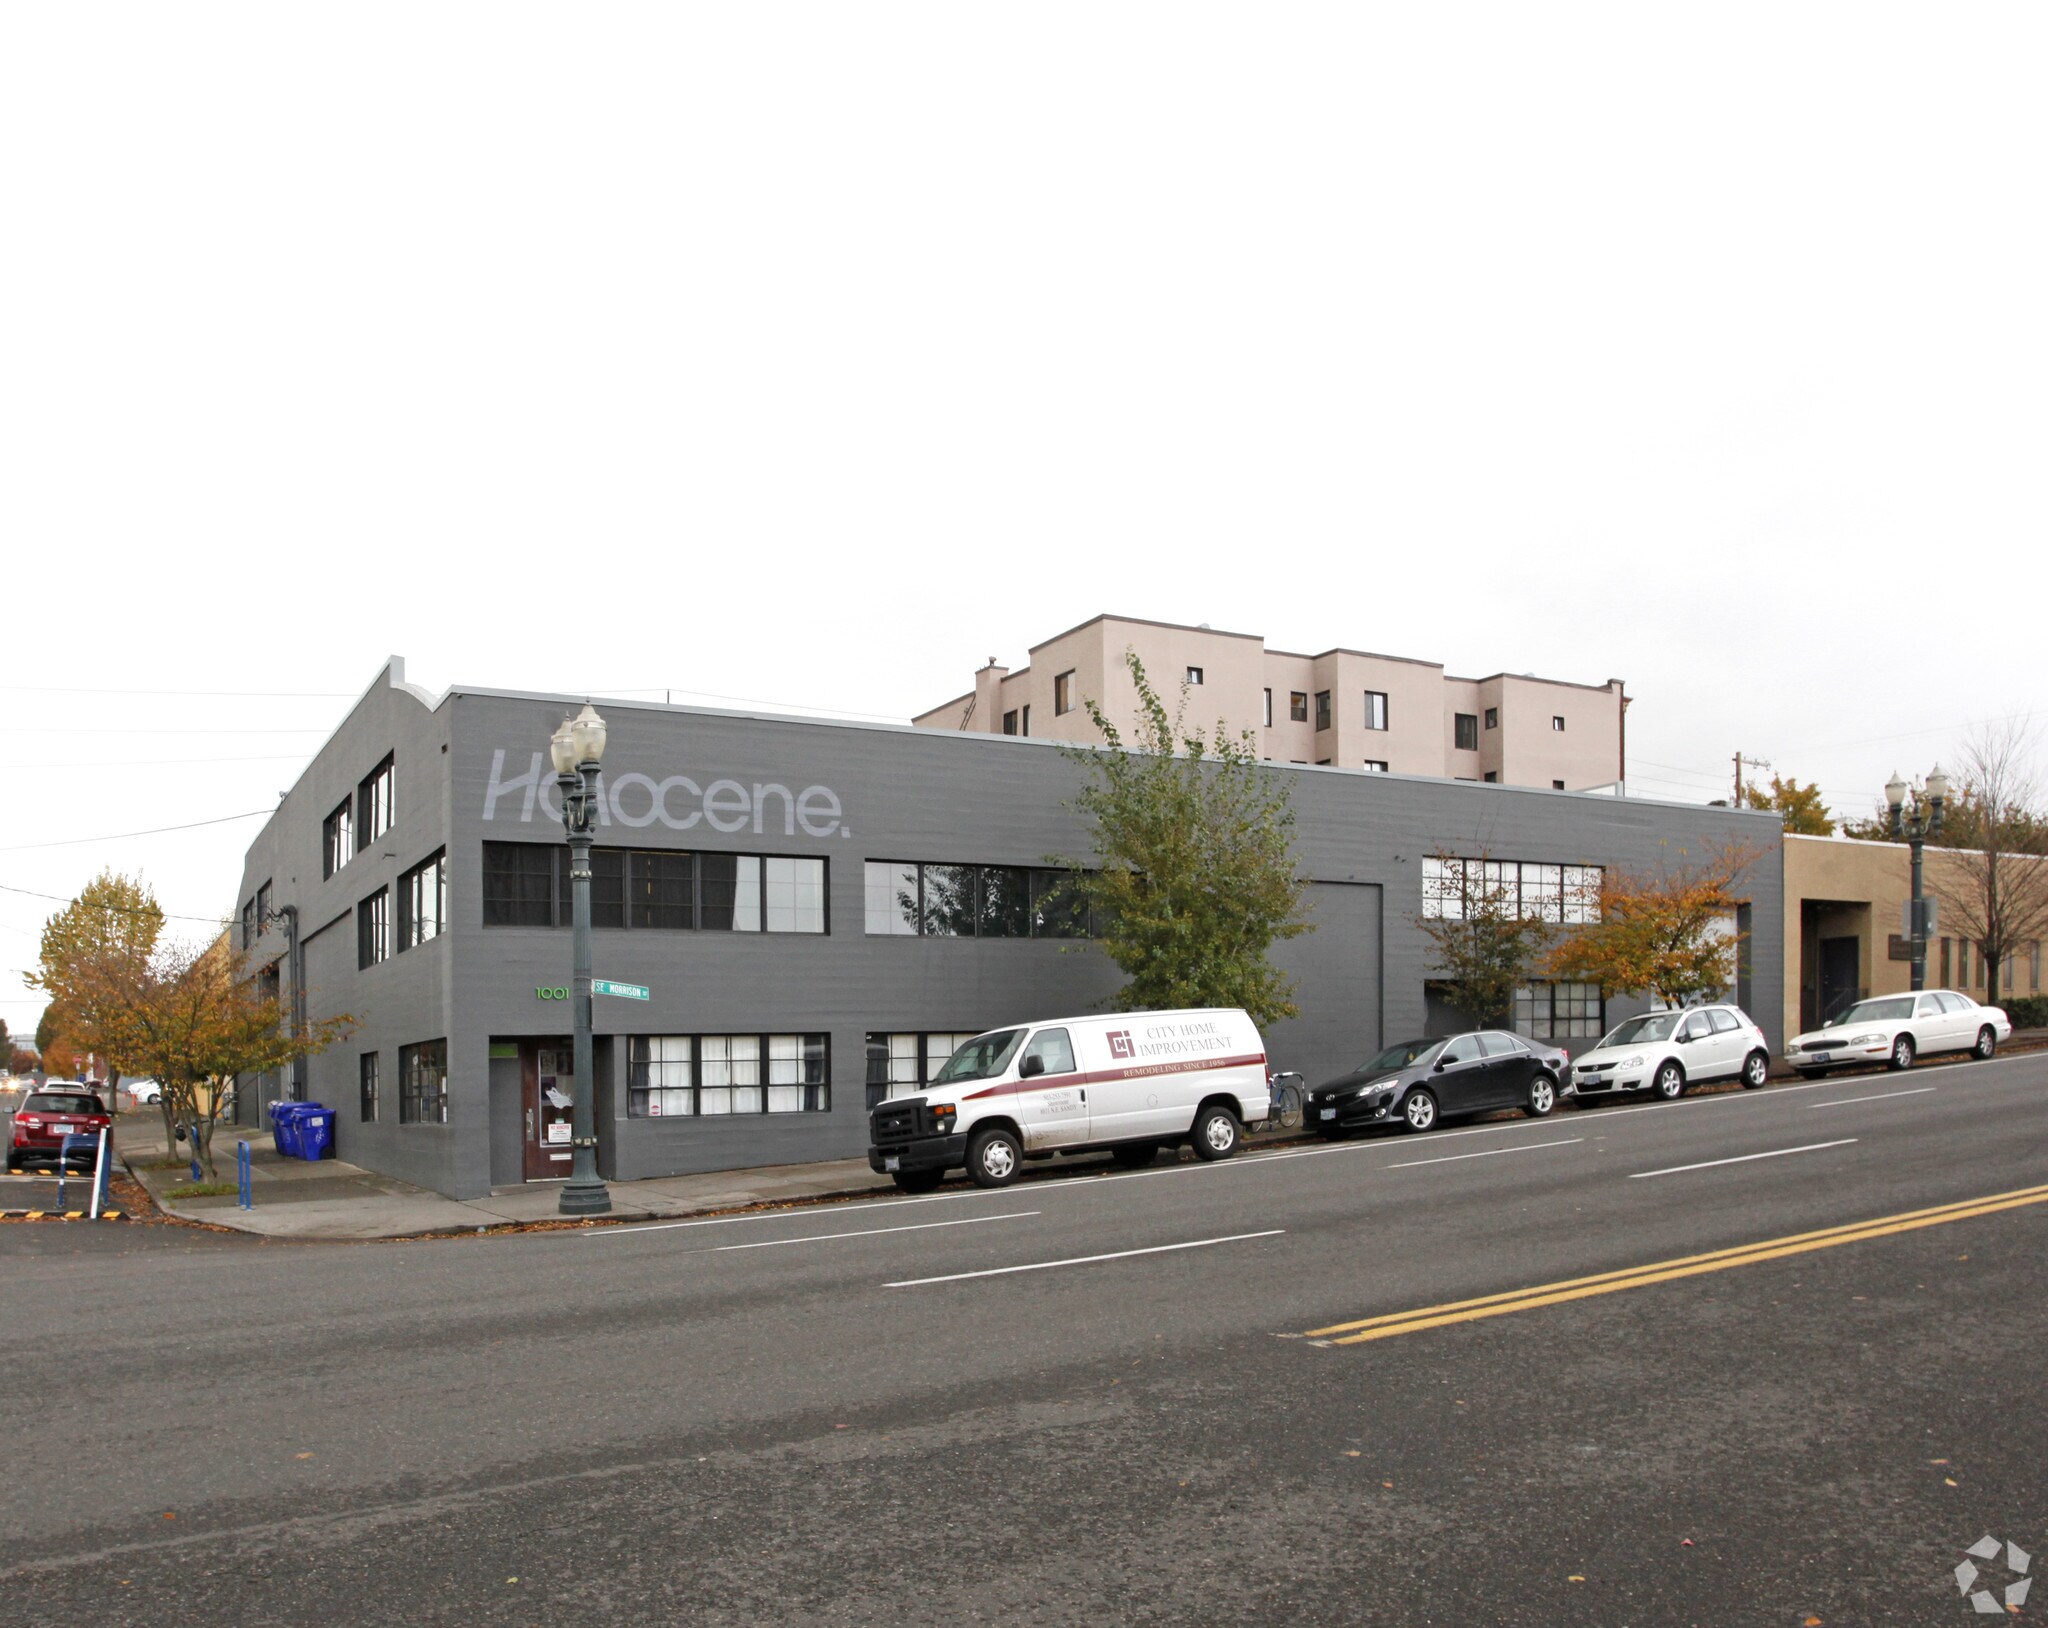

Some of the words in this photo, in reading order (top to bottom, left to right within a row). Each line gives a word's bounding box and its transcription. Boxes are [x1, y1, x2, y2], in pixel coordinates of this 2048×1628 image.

[536, 987, 569, 1000] 1001
[596, 982, 605, 993] SE
[609, 984, 641, 998] MORRISON
[1147, 1025, 1176, 1039] CITY
[1180, 1022, 1218, 1036] HOME
[1139, 1036, 1232, 1057] IMPROVEMENT
[1123, 1064, 1181, 1078] REMODELING
[1183, 1061, 1207, 1071] SINCE
[1209, 1059, 1226, 1069] 1956
